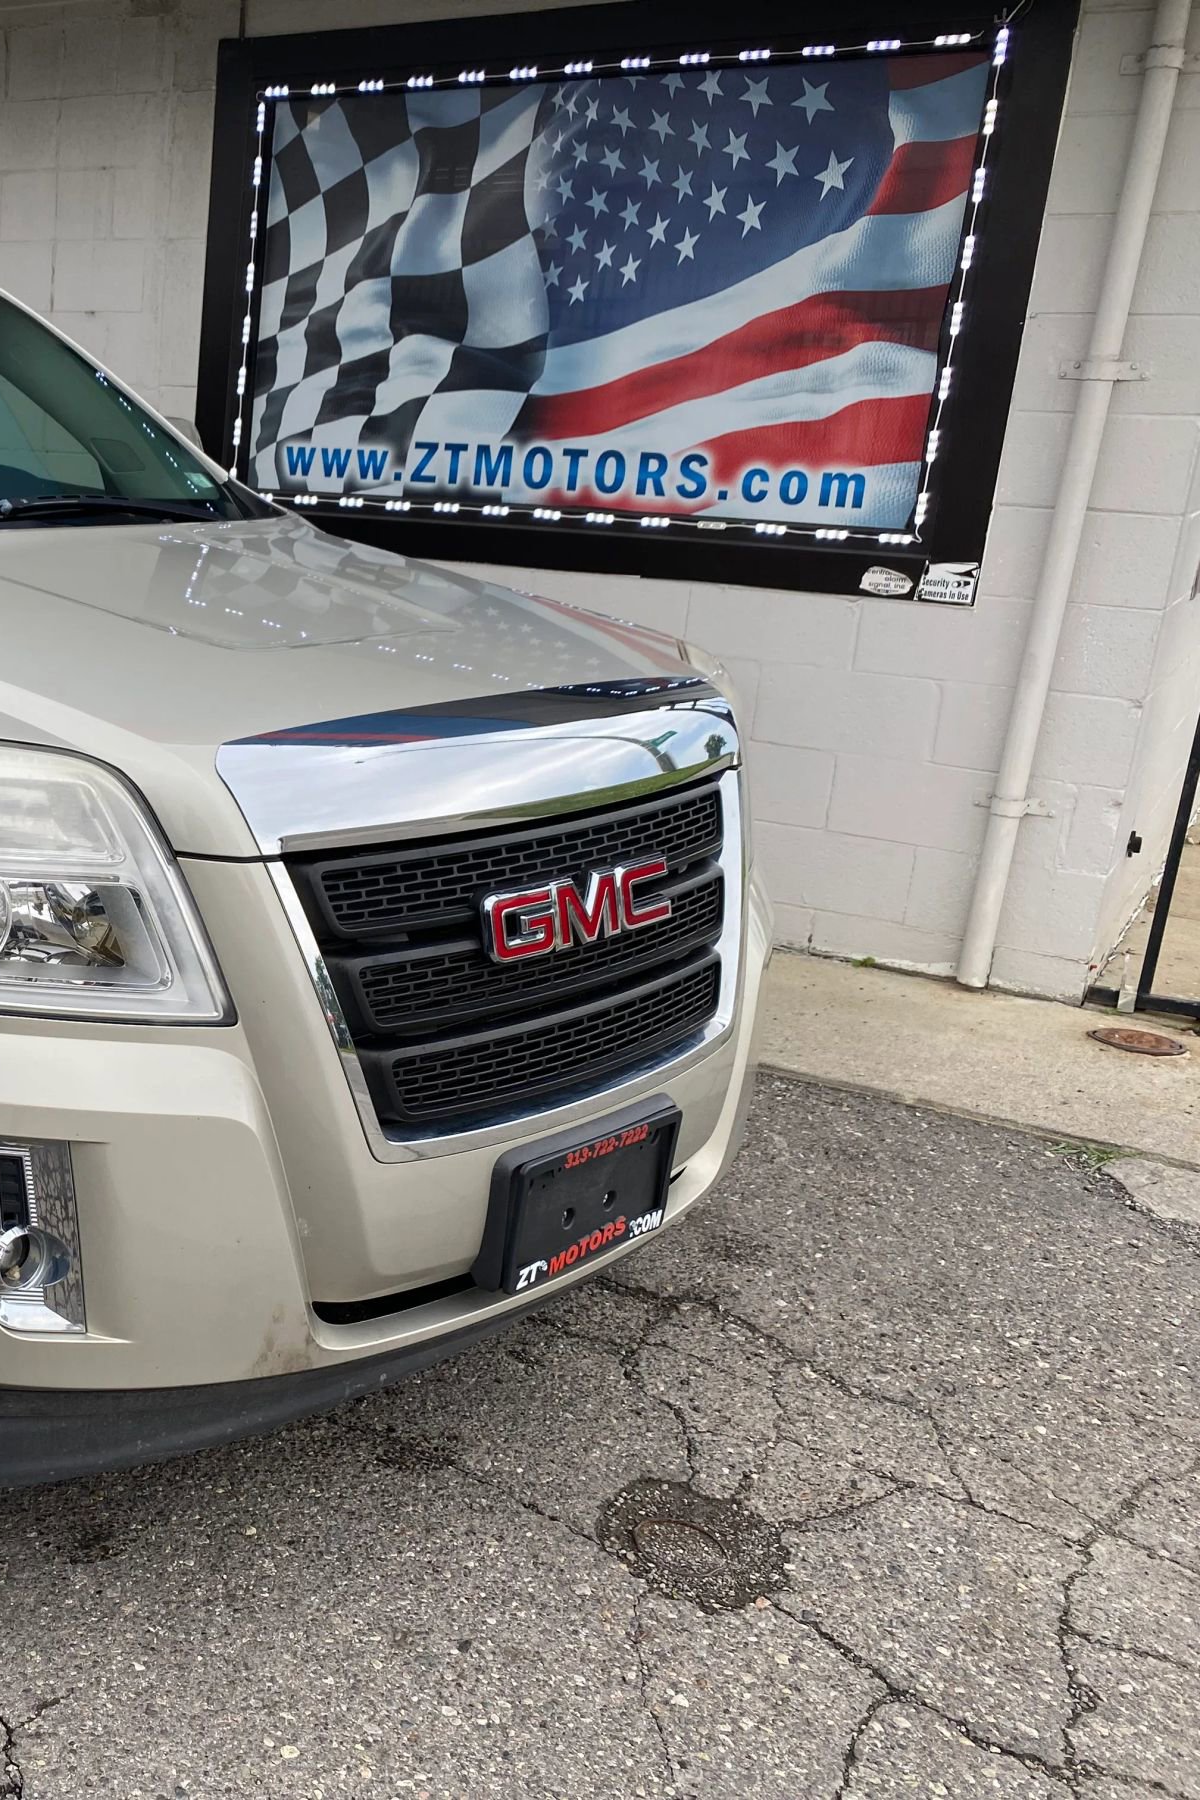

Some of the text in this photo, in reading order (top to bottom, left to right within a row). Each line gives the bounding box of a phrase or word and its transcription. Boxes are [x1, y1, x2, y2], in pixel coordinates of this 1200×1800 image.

[286, 441, 866, 509] www.ZTMOTORS.com
[919, 588, 970, 601] Cameras In Use
[921, 576, 950, 590] Security
[481, 853, 672, 963] GMC
